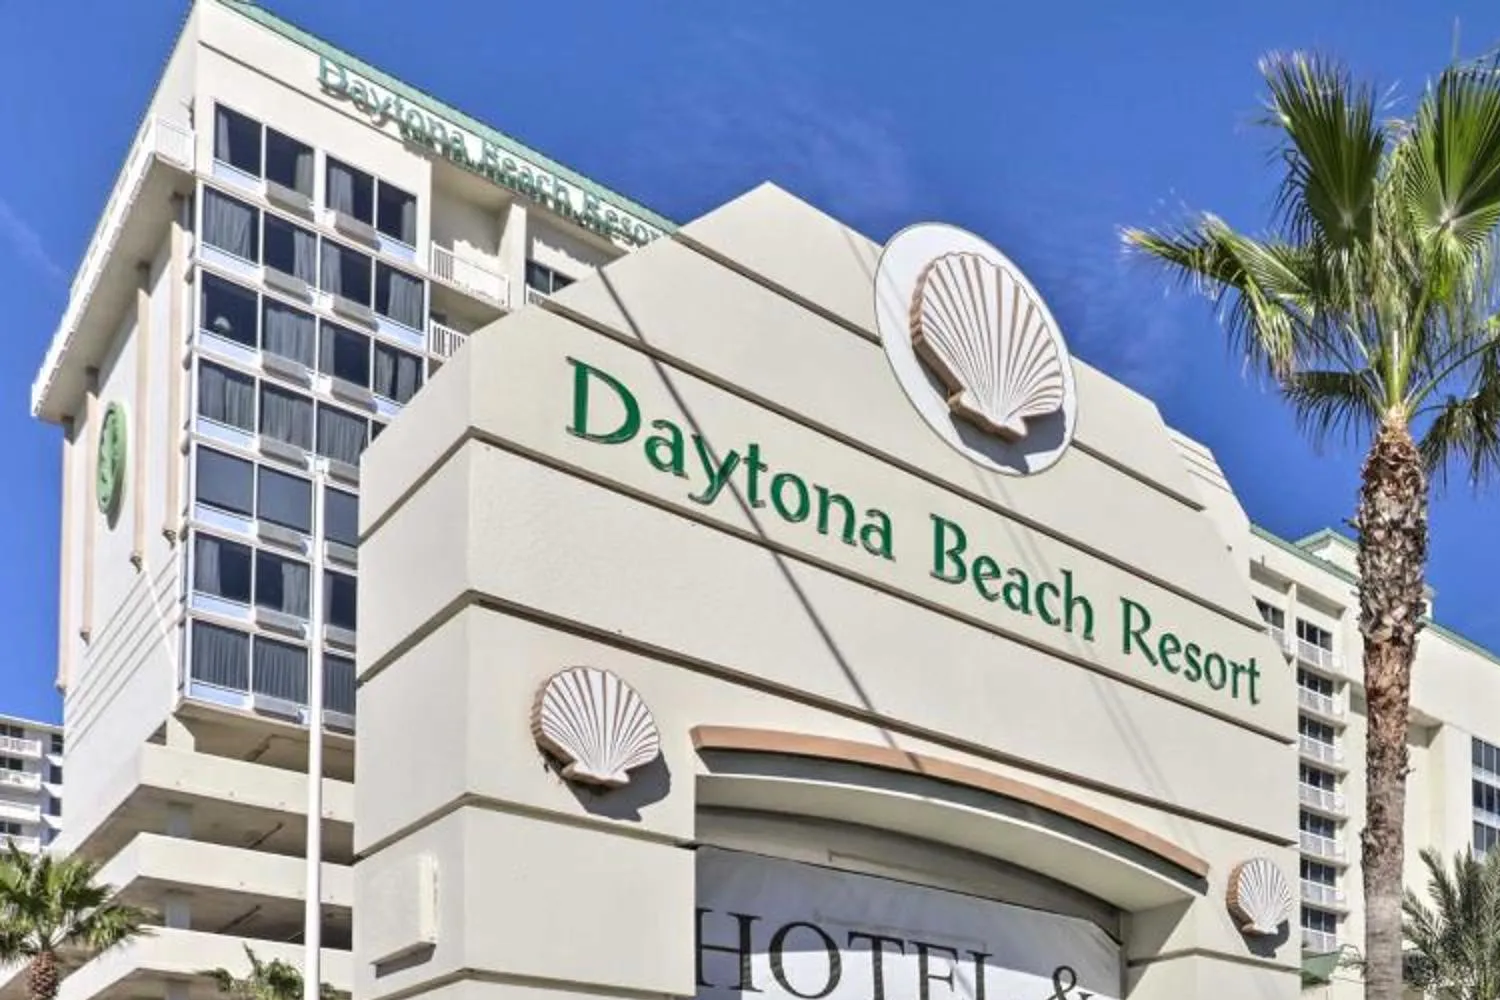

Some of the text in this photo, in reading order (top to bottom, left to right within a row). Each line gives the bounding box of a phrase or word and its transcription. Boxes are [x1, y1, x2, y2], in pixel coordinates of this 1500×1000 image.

[318, 55, 664, 246] Daytona Beach Resor
[566, 356, 1261, 705] Daytona Beach Resort
